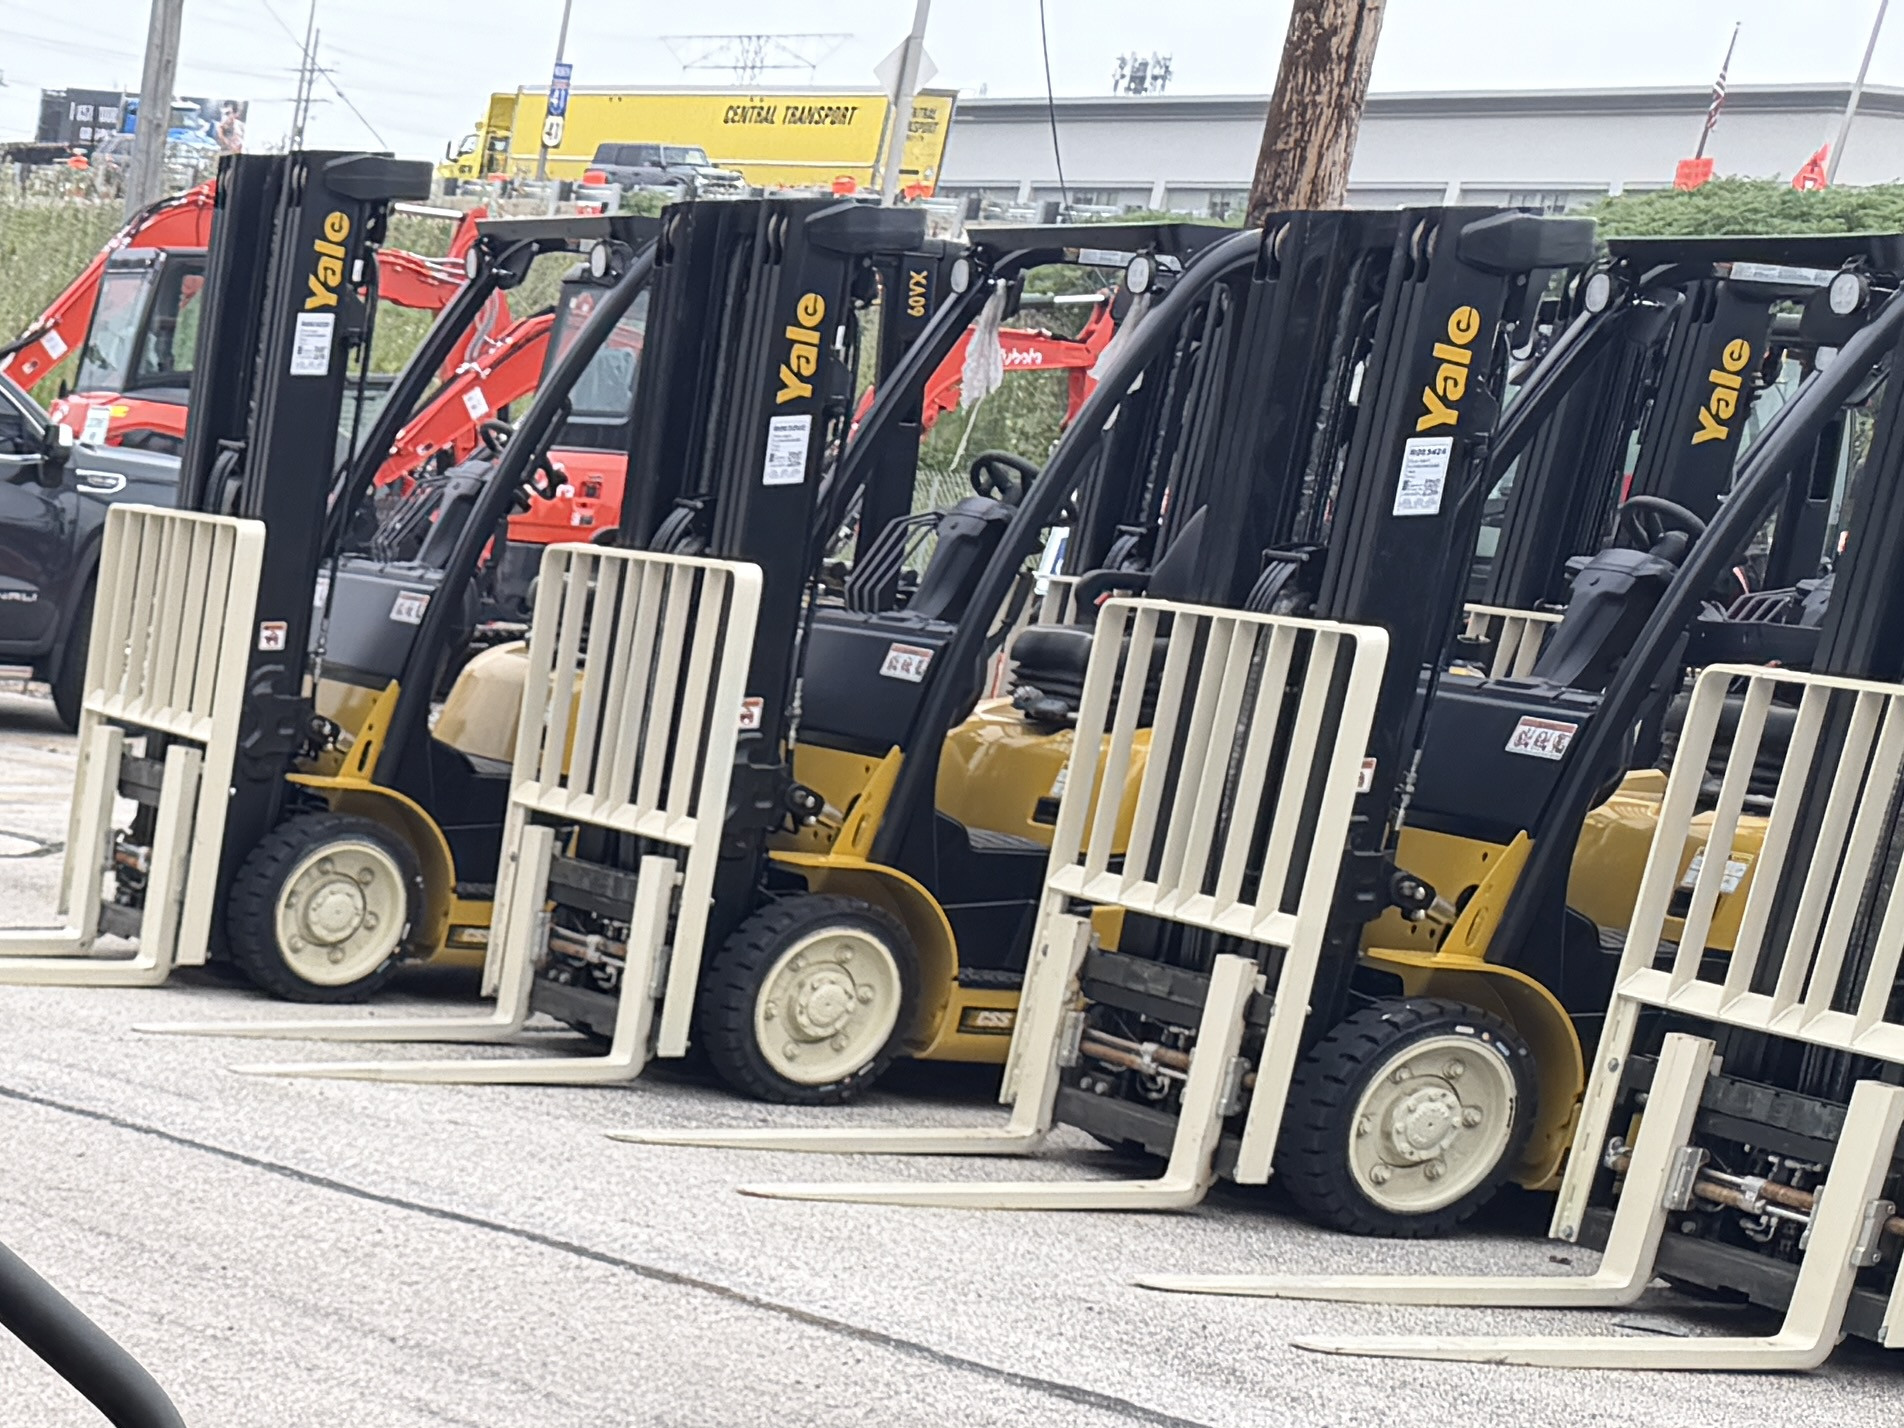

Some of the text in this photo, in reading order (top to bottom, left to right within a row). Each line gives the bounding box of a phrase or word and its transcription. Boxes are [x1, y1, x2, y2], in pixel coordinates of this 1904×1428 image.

[723, 105, 861, 125] CENTRAL TRANSPORT
[304, 211, 350, 310] Yale
[907, 270, 928, 317] 60VX
[776, 293, 826, 405] Yale
[1001, 347, 1043, 365] ubota
[1416, 305, 1481, 432] Yale
[1691, 338, 1751, 445] Yale
